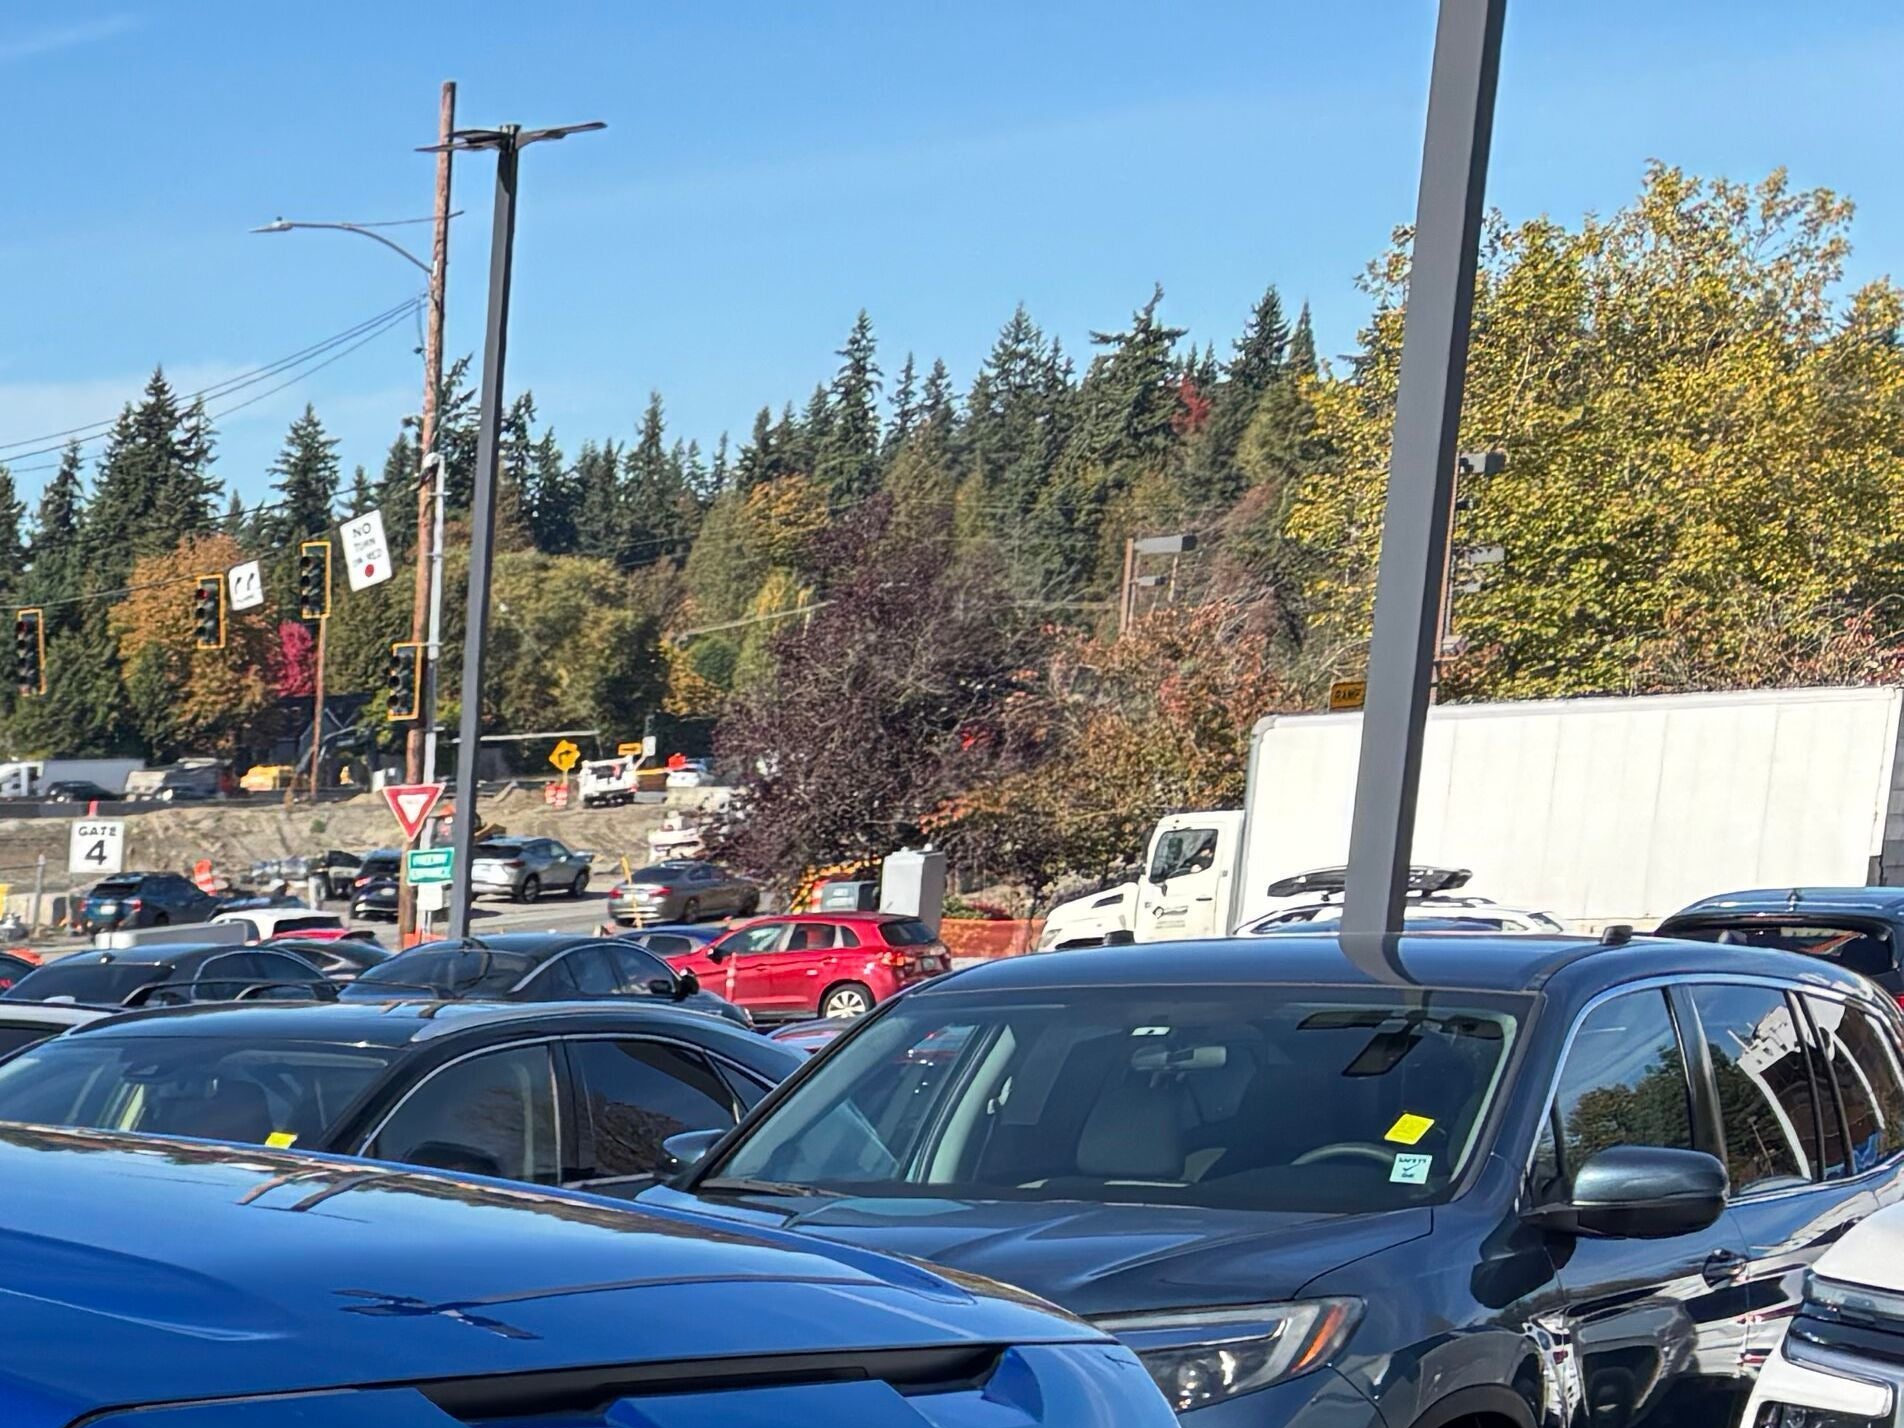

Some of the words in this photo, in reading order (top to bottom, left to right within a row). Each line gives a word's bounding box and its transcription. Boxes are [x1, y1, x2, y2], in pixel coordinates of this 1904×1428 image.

[353, 522, 372, 539] NO
[78, 826, 118, 837] GATE
[84, 839, 108, 866] 4
